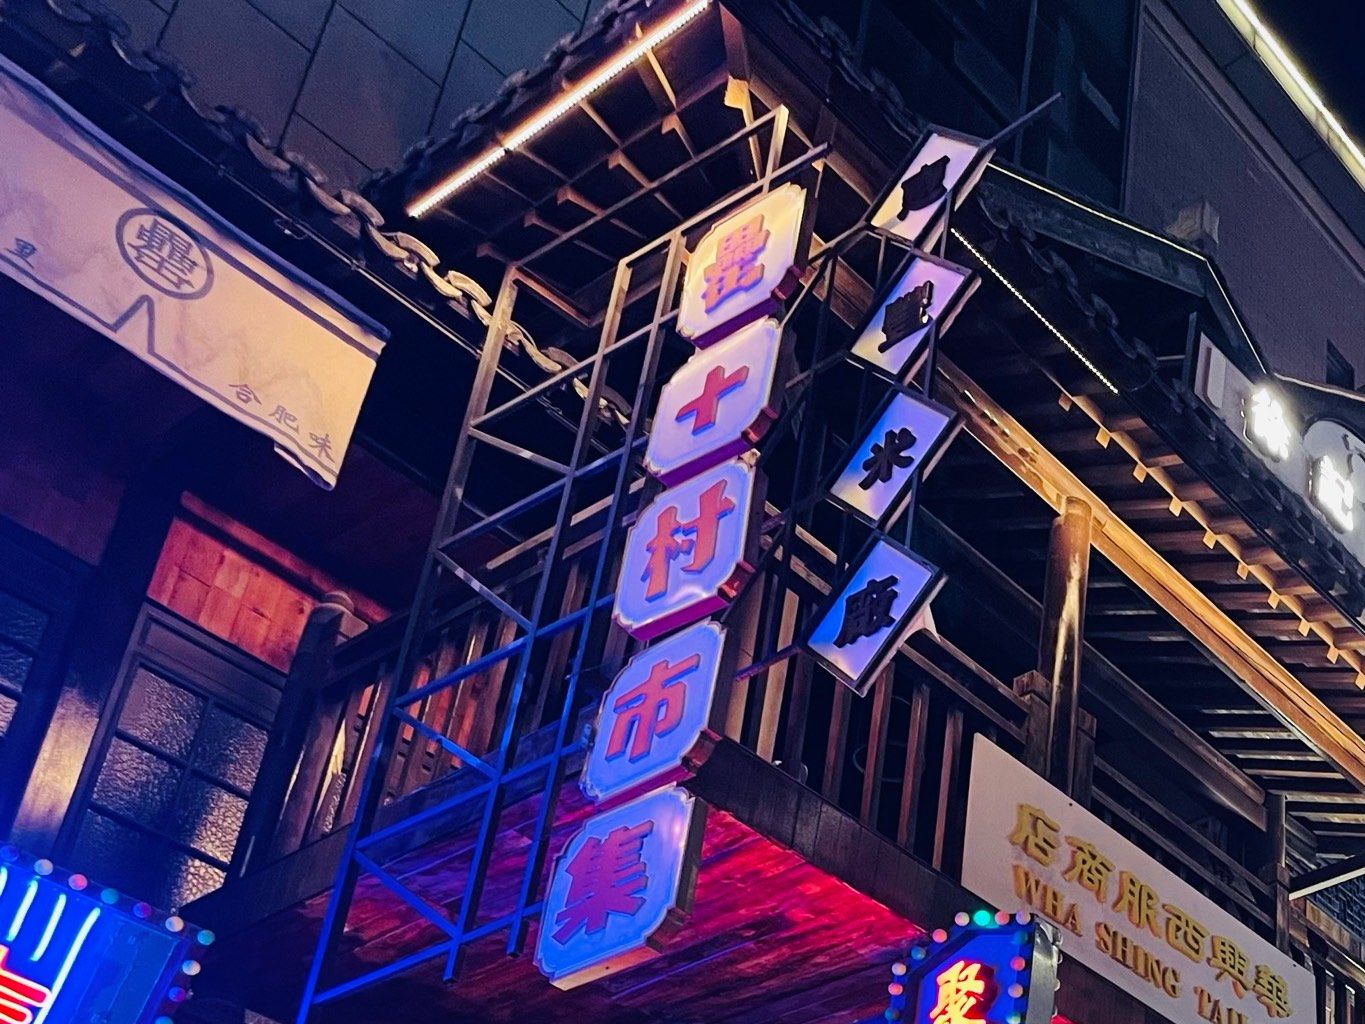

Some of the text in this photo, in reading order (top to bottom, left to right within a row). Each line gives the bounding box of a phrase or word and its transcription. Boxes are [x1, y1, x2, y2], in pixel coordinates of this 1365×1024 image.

[229, 383, 335, 463] 合肥味
[1012, 864, 1083, 936] WHA
[1095, 922, 1181, 999] SHING
